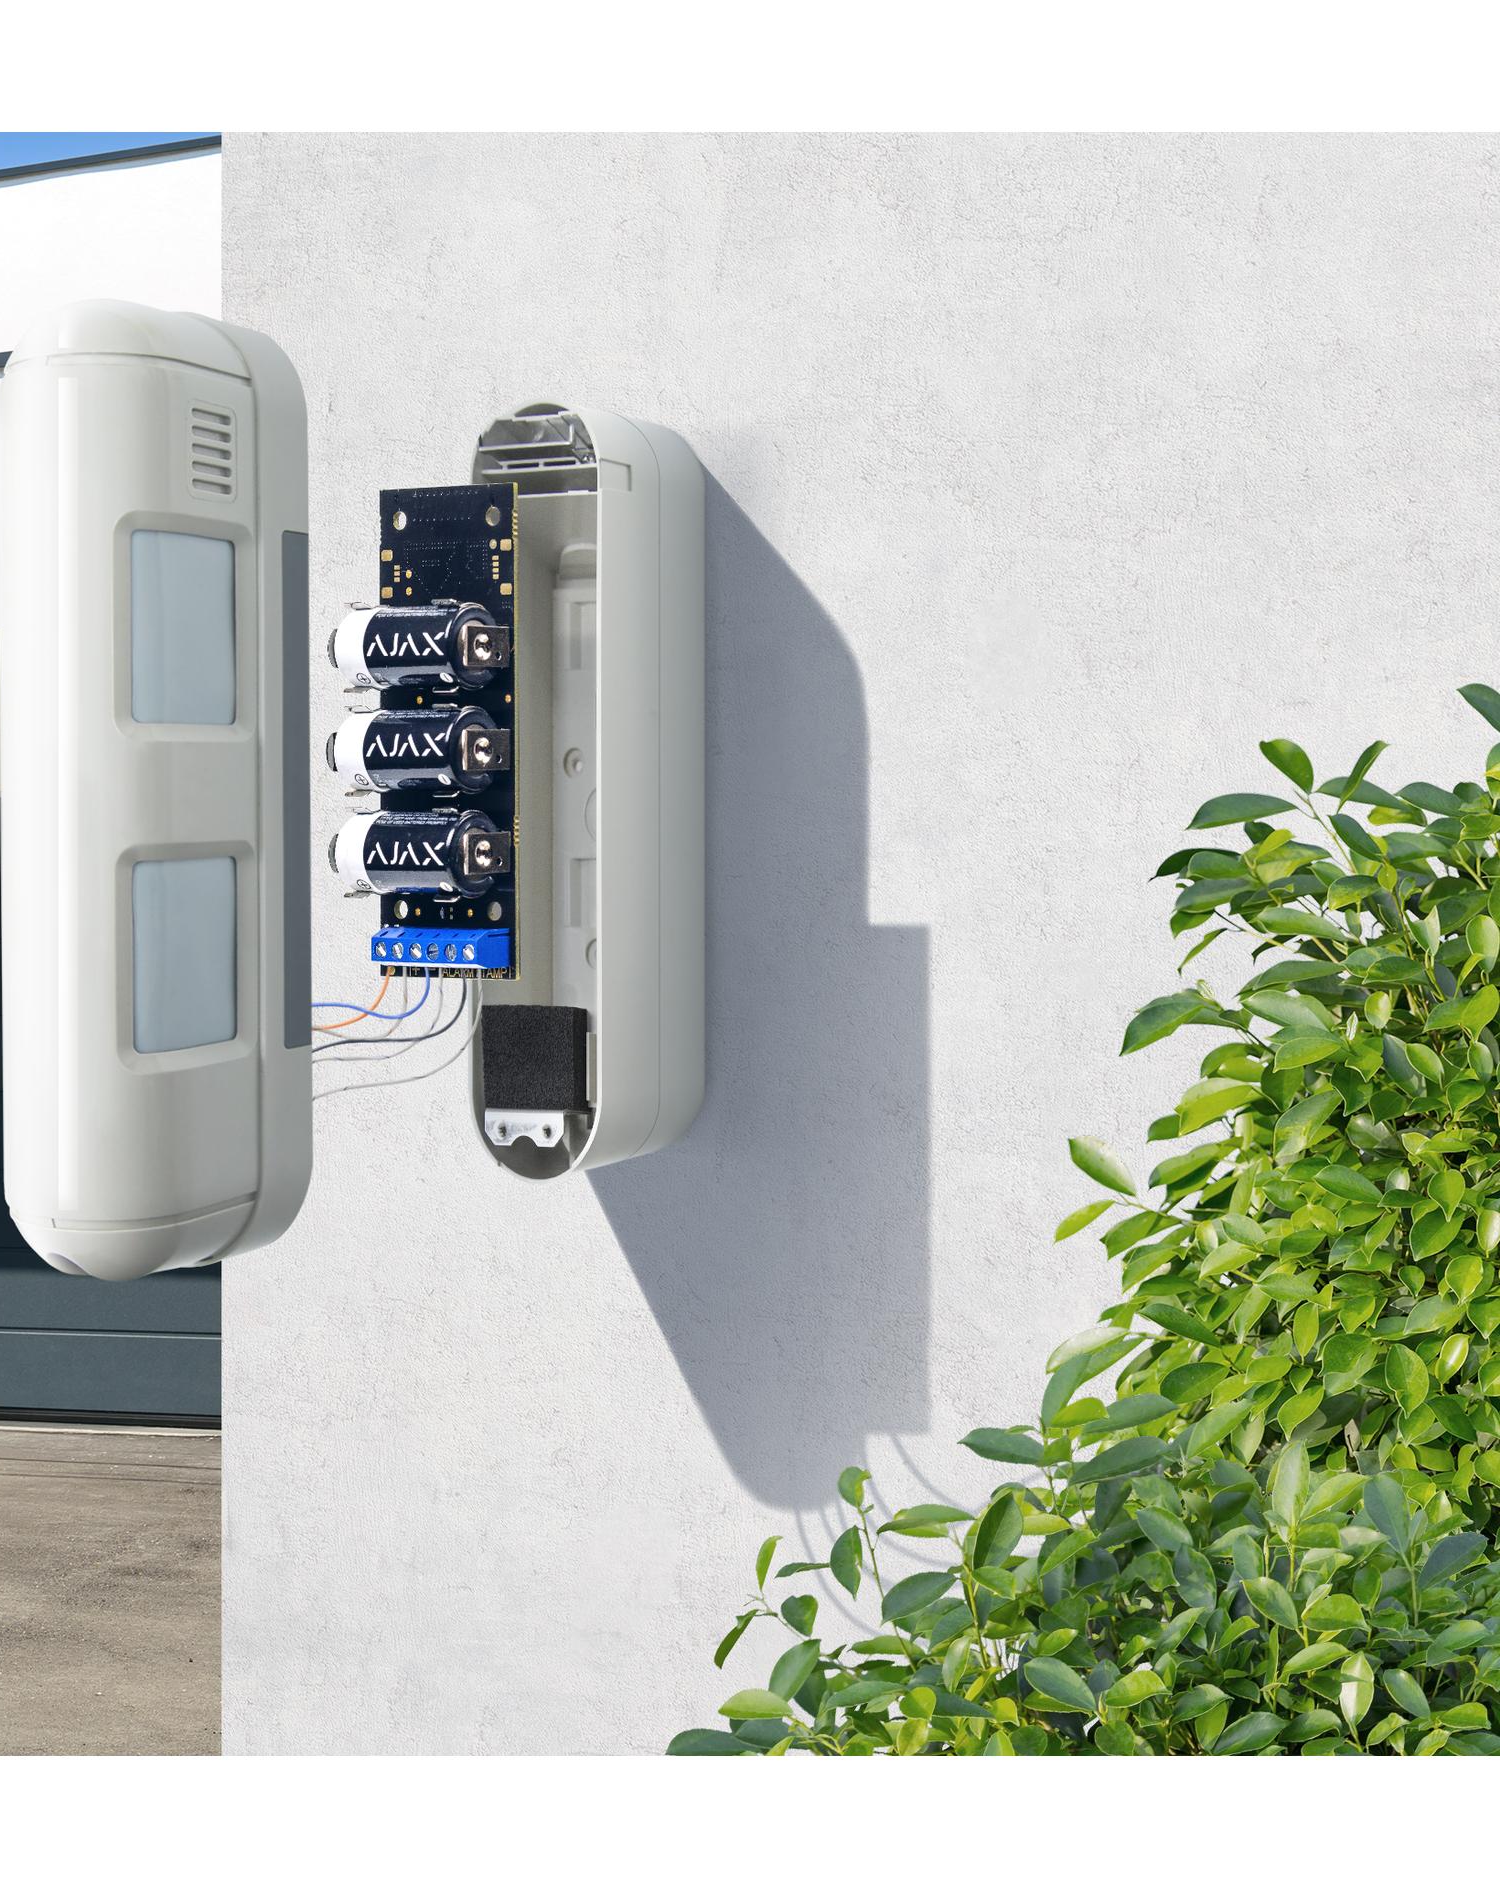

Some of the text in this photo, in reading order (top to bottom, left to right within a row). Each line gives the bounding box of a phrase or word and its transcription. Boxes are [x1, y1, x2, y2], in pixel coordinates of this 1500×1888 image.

[366, 631, 445, 657] AJAX
[365, 732, 446, 758] AJAX
[366, 841, 445, 866] AJAX
